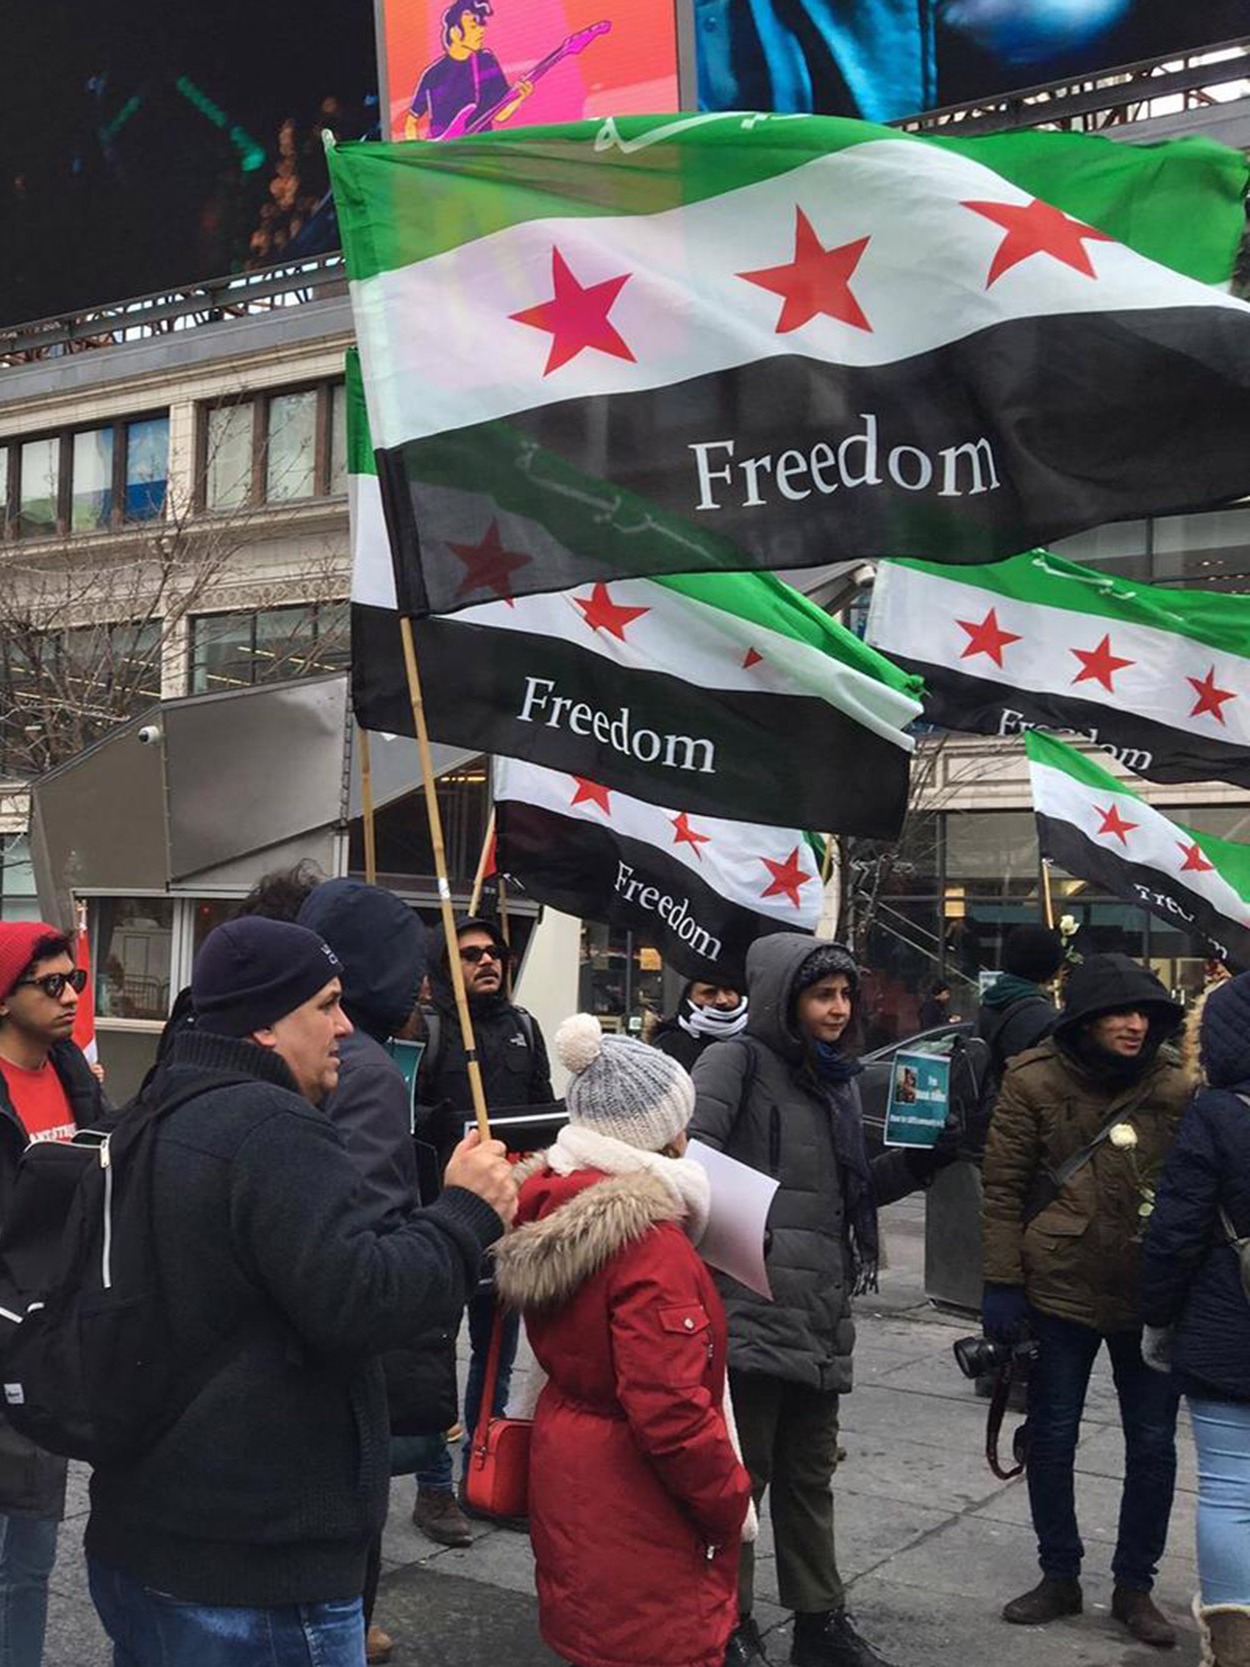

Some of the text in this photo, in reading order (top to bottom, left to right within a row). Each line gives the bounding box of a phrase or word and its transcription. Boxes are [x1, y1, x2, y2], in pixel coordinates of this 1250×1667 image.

[687, 413, 1002, 511] Freedom
[517, 675, 717, 774] Freedom
[613, 859, 723, 962] Freedom
